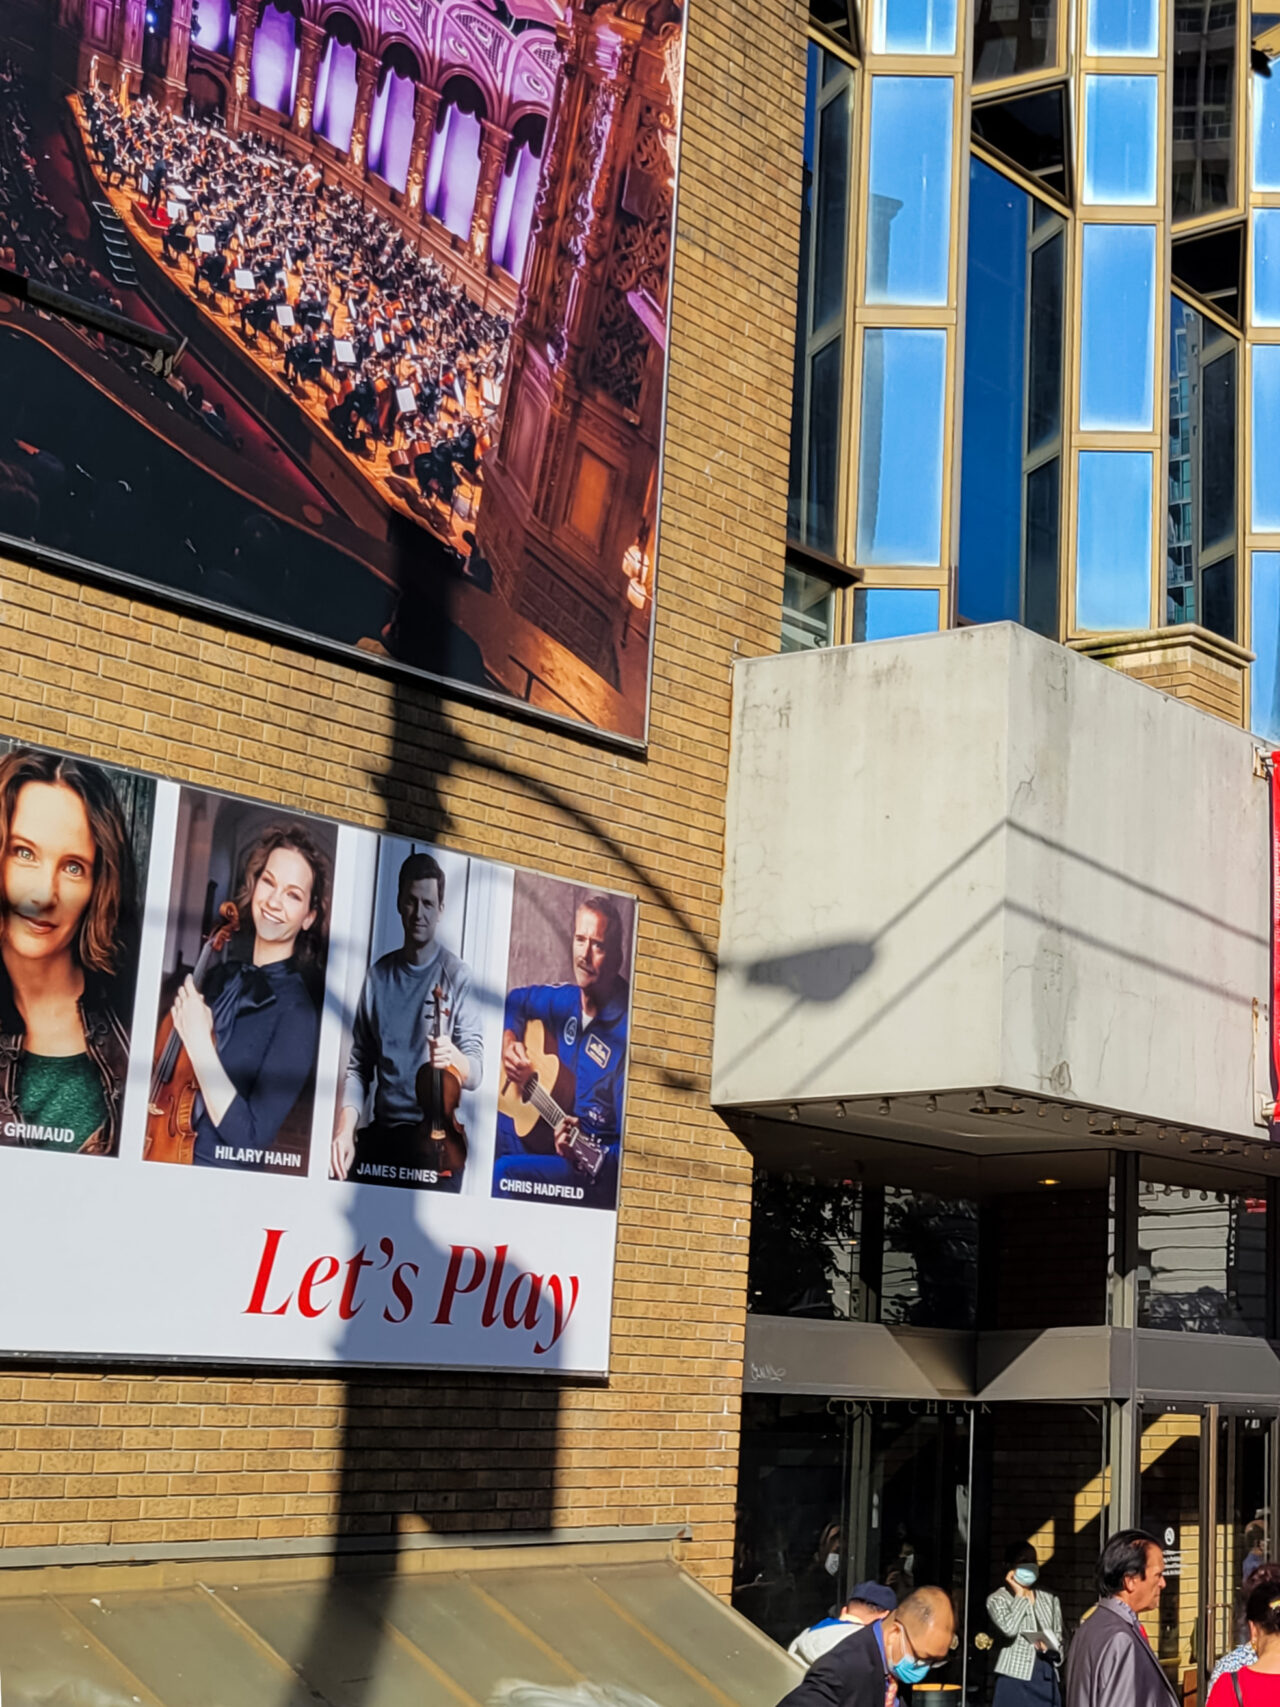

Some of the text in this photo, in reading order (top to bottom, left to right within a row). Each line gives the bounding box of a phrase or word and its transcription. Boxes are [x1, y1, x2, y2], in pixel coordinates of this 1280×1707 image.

[4, 1121, 75, 1143] GRIMAUD
[214, 1145, 302, 1168] HILARY HAHN
[357, 1163, 438, 1183] JAMES EHNES
[500, 1178, 584, 1200] CHRIS HADFIELD
[240, 1228, 580, 1354] Let’s Play
